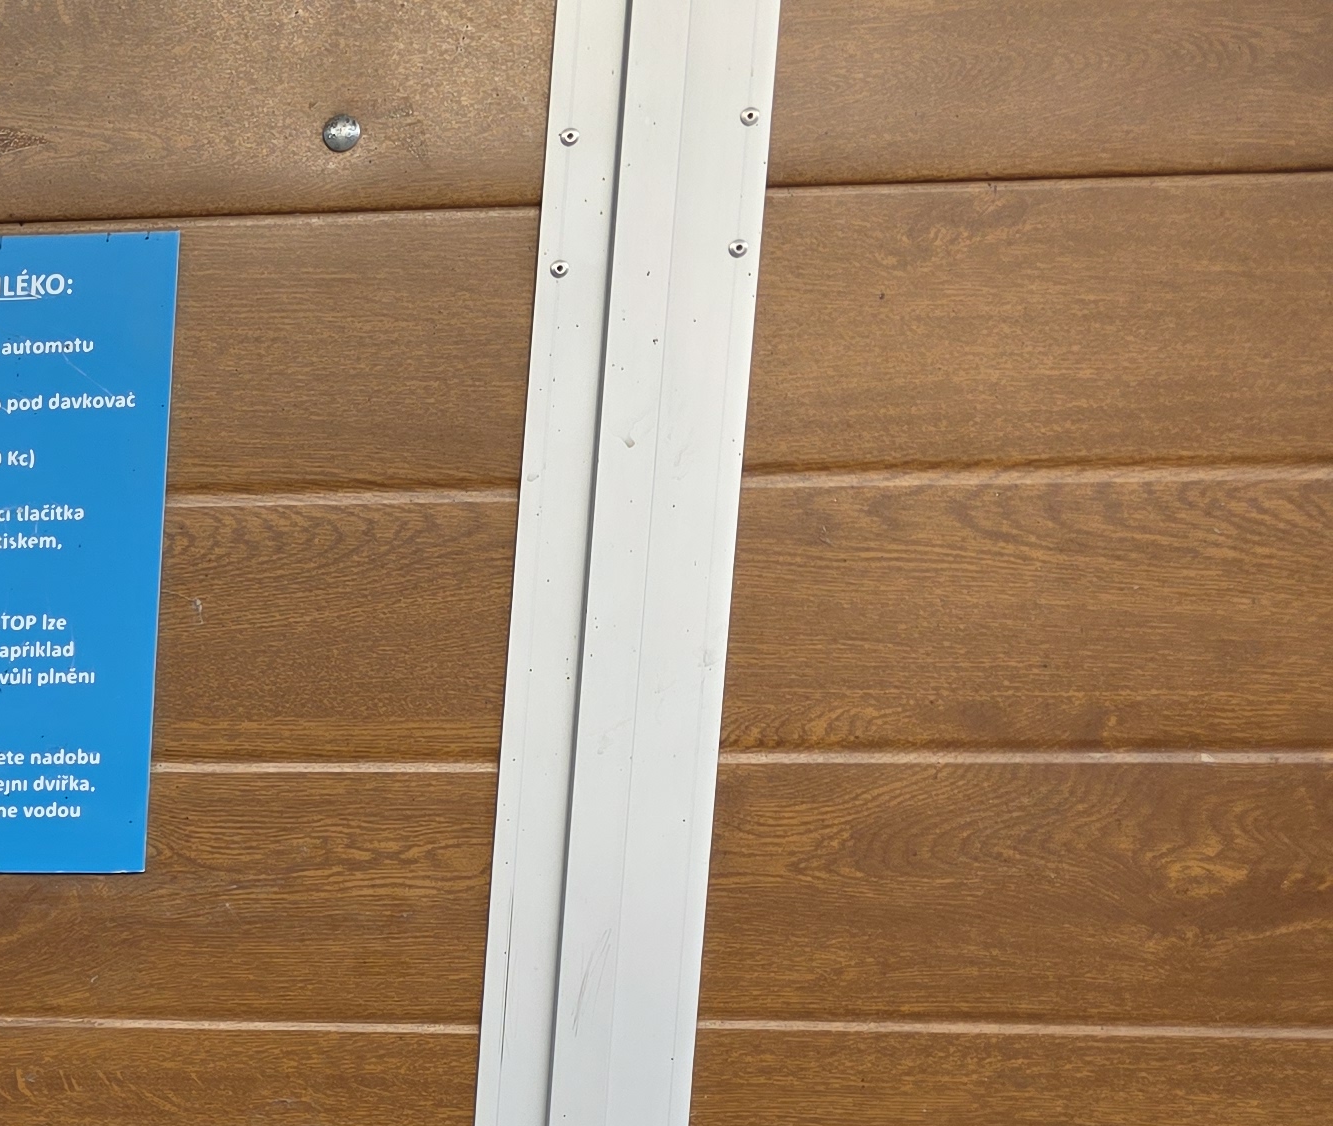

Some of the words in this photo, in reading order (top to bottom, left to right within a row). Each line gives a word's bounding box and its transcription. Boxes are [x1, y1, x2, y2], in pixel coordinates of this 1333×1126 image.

[2, 338, 93, 355] automatu
[5, 395, 42, 414] pod
[43, 614, 66, 630] lze
[23, 802, 80, 817] vodou
